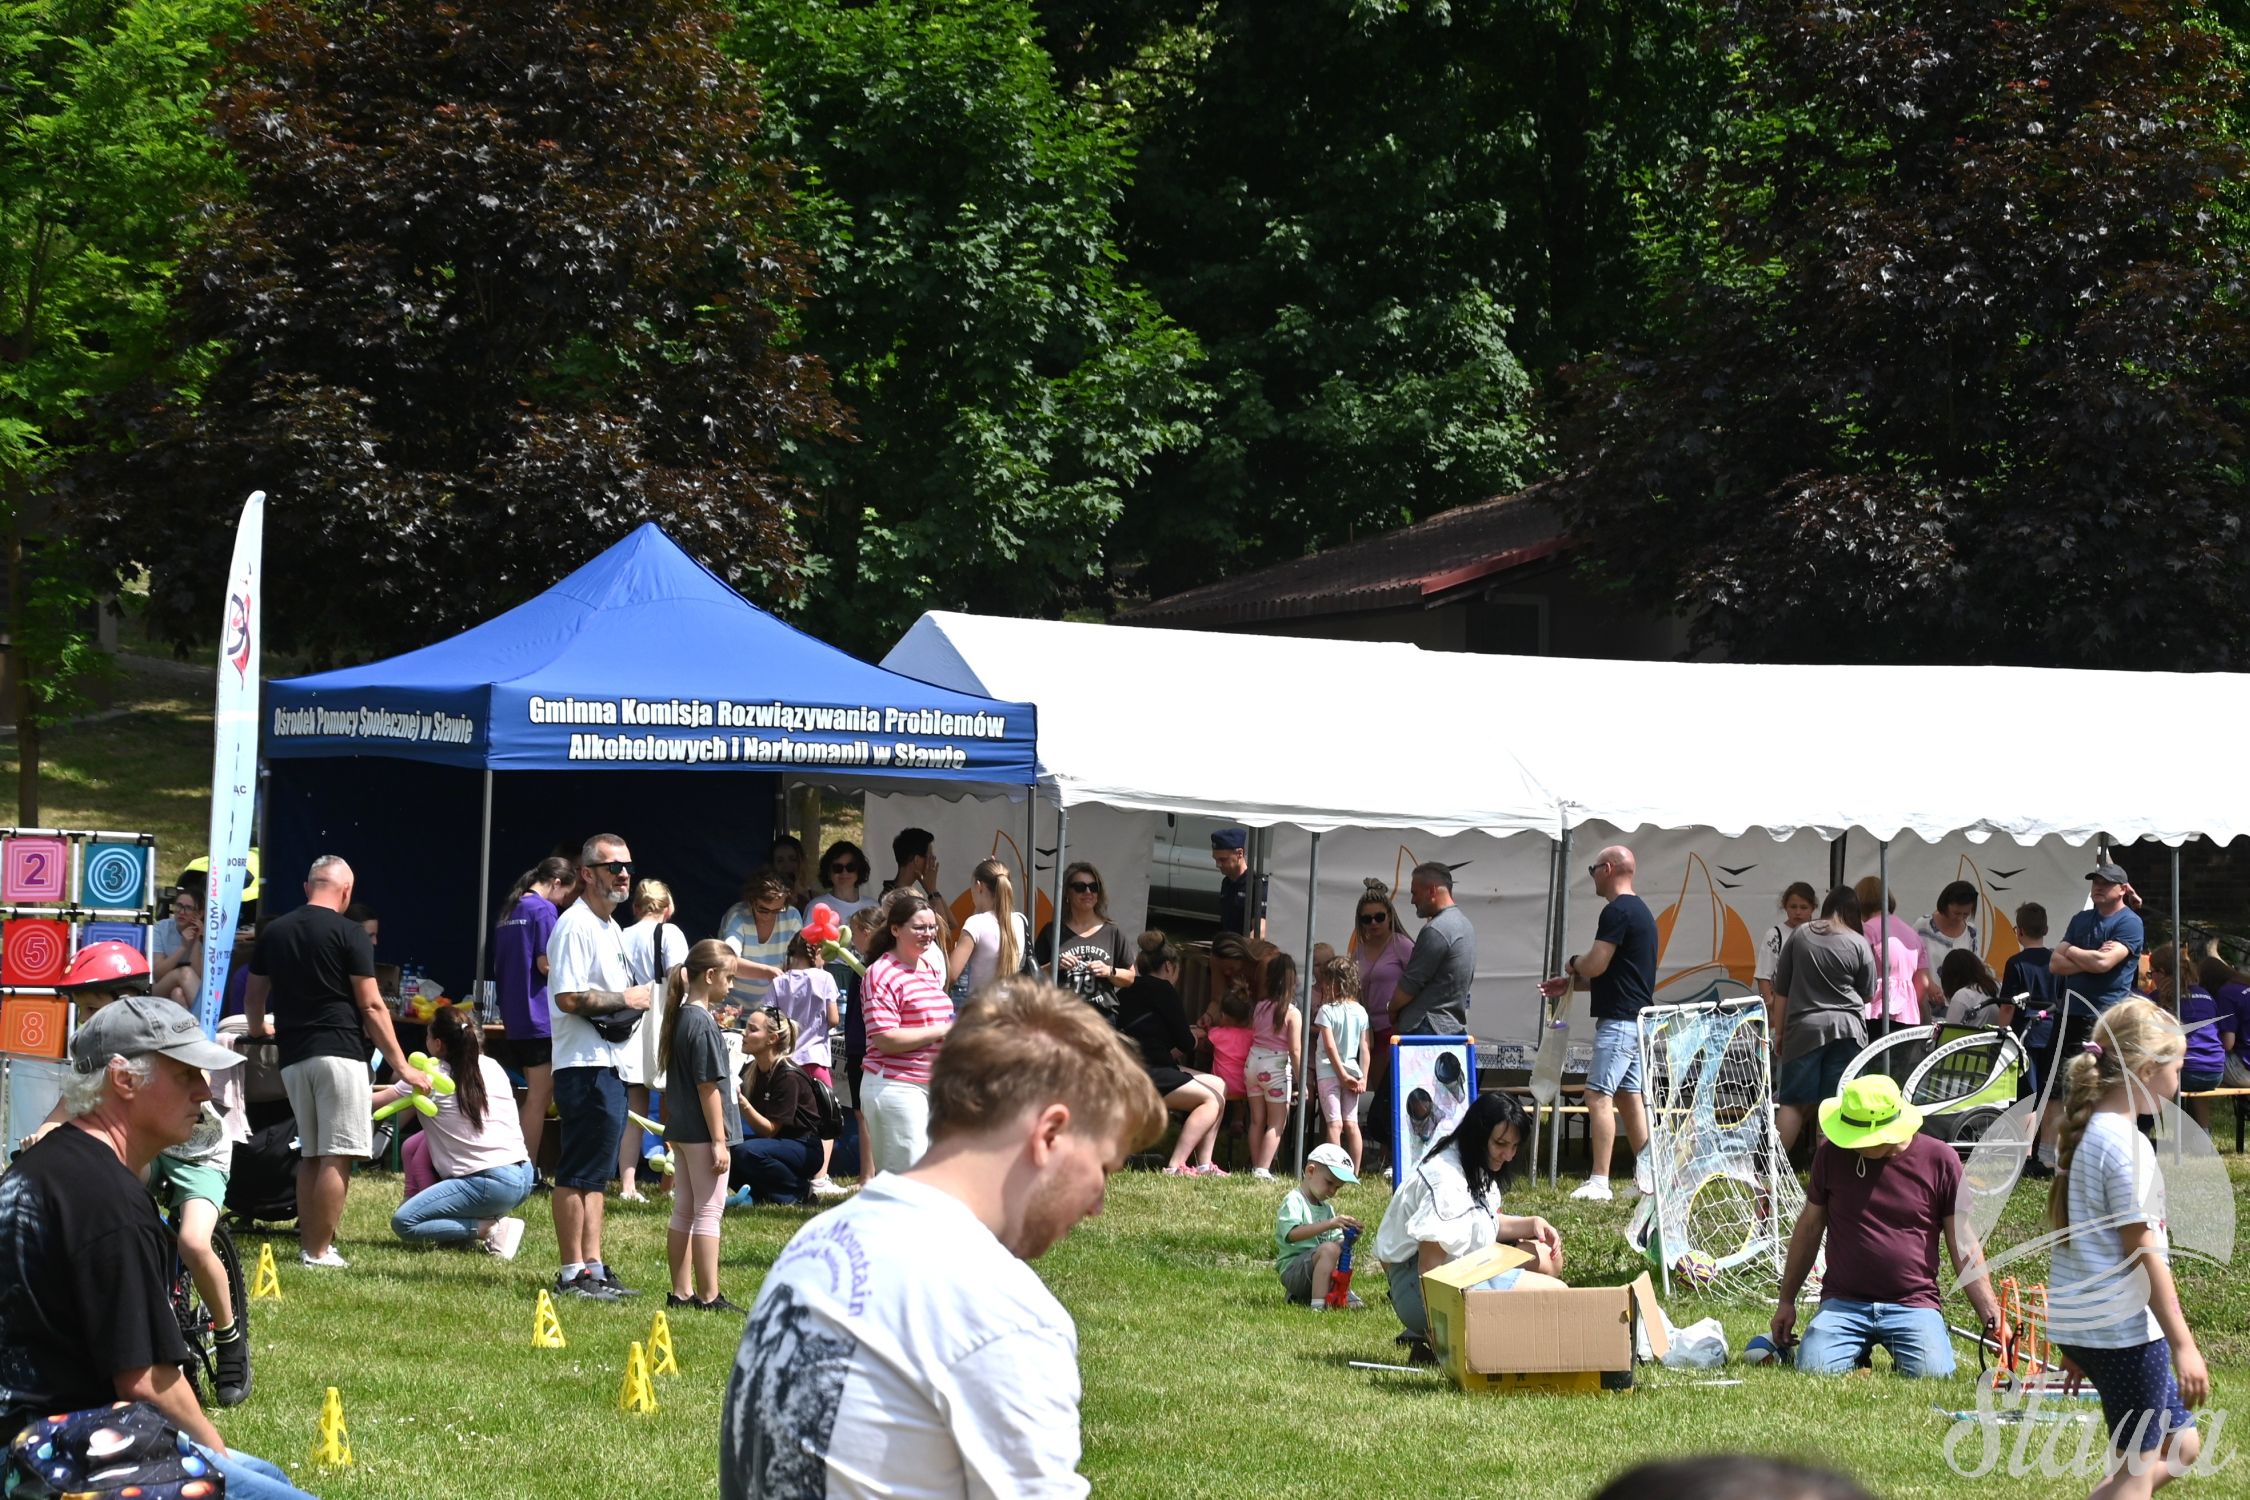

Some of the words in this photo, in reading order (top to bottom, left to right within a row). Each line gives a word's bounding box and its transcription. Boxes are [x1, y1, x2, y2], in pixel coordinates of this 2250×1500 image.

[274, 706, 315, 736] Ośrodek
[317, 706, 358, 737] Pomocy
[359, 706, 420, 741] Społecznej
[420, 716, 432, 740] w
[432, 711, 473, 744] Sławie
[528, 695, 617, 724] Gminna
[620, 698, 713, 728] Komisja
[717, 700, 880, 733] Rozwiązywania
[884, 707, 1005, 738] Problemów
[568, 733, 727, 764] Alkoholowych
[730, 736, 740, 761] i
[743, 737, 869, 765] Narkomanii
[872, 745, 891, 766] w
[894, 742, 967, 770] Sławie
[24, 853, 46, 885] 2
[105, 861, 124, 892] 3
[24, 937, 48, 968] 5
[20, 1011, 44, 1047] 8
